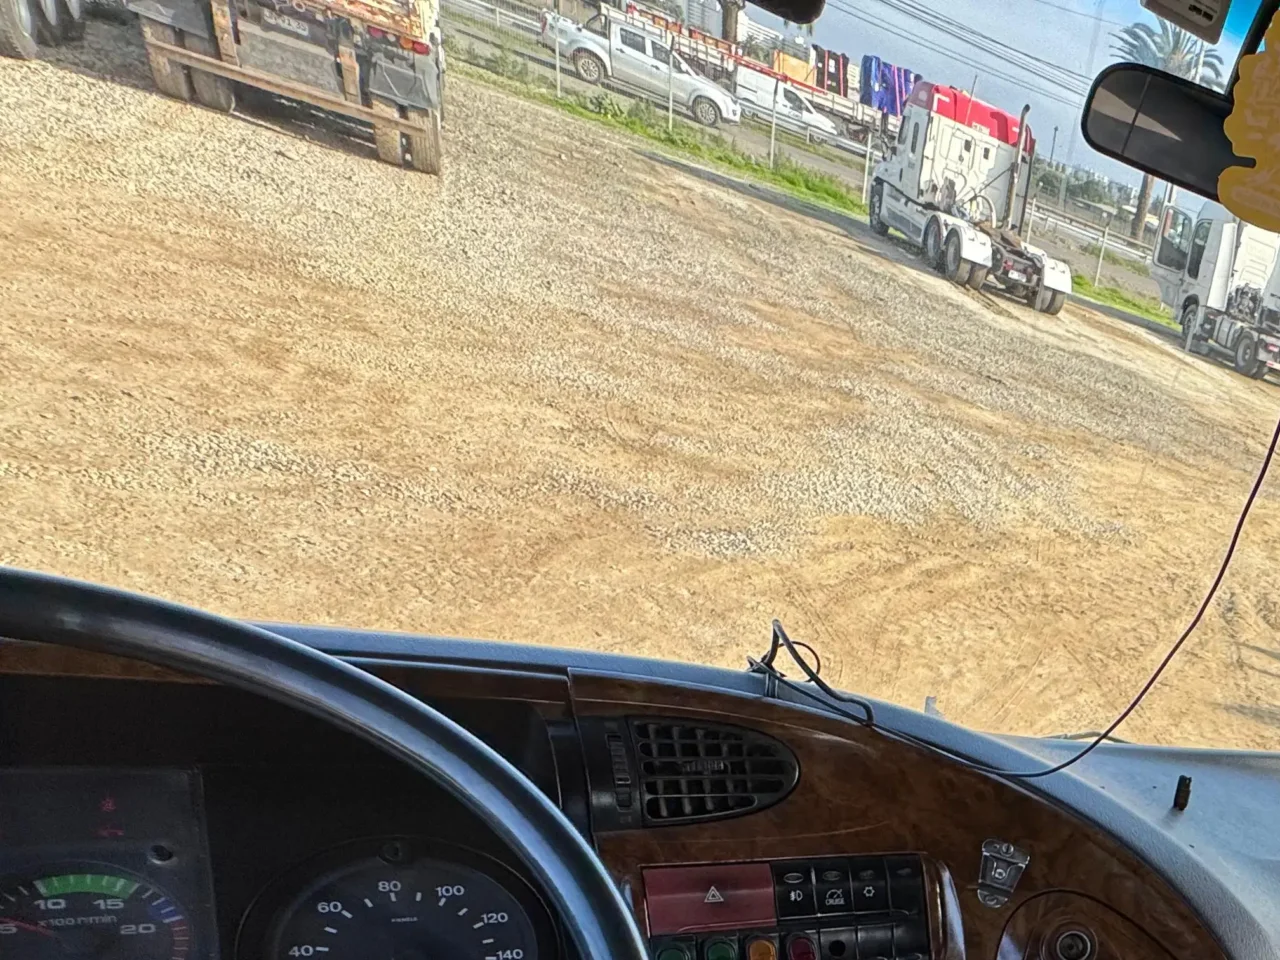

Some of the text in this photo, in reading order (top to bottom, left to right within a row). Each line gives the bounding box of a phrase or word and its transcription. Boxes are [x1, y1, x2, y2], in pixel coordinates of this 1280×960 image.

[378, 881, 401, 892] 80
[435, 885, 465, 897] 100
[33, 898, 66, 910] 10
[93, 898, 124, 910] 15
[825, 897, 845, 905] CRUISE
[317, 902, 342, 913] 60
[481, 913, 508, 924] 120
[120, 923, 156, 935] 20
[288, 945, 314, 957] 40
[496, 949, 523, 960] 140
